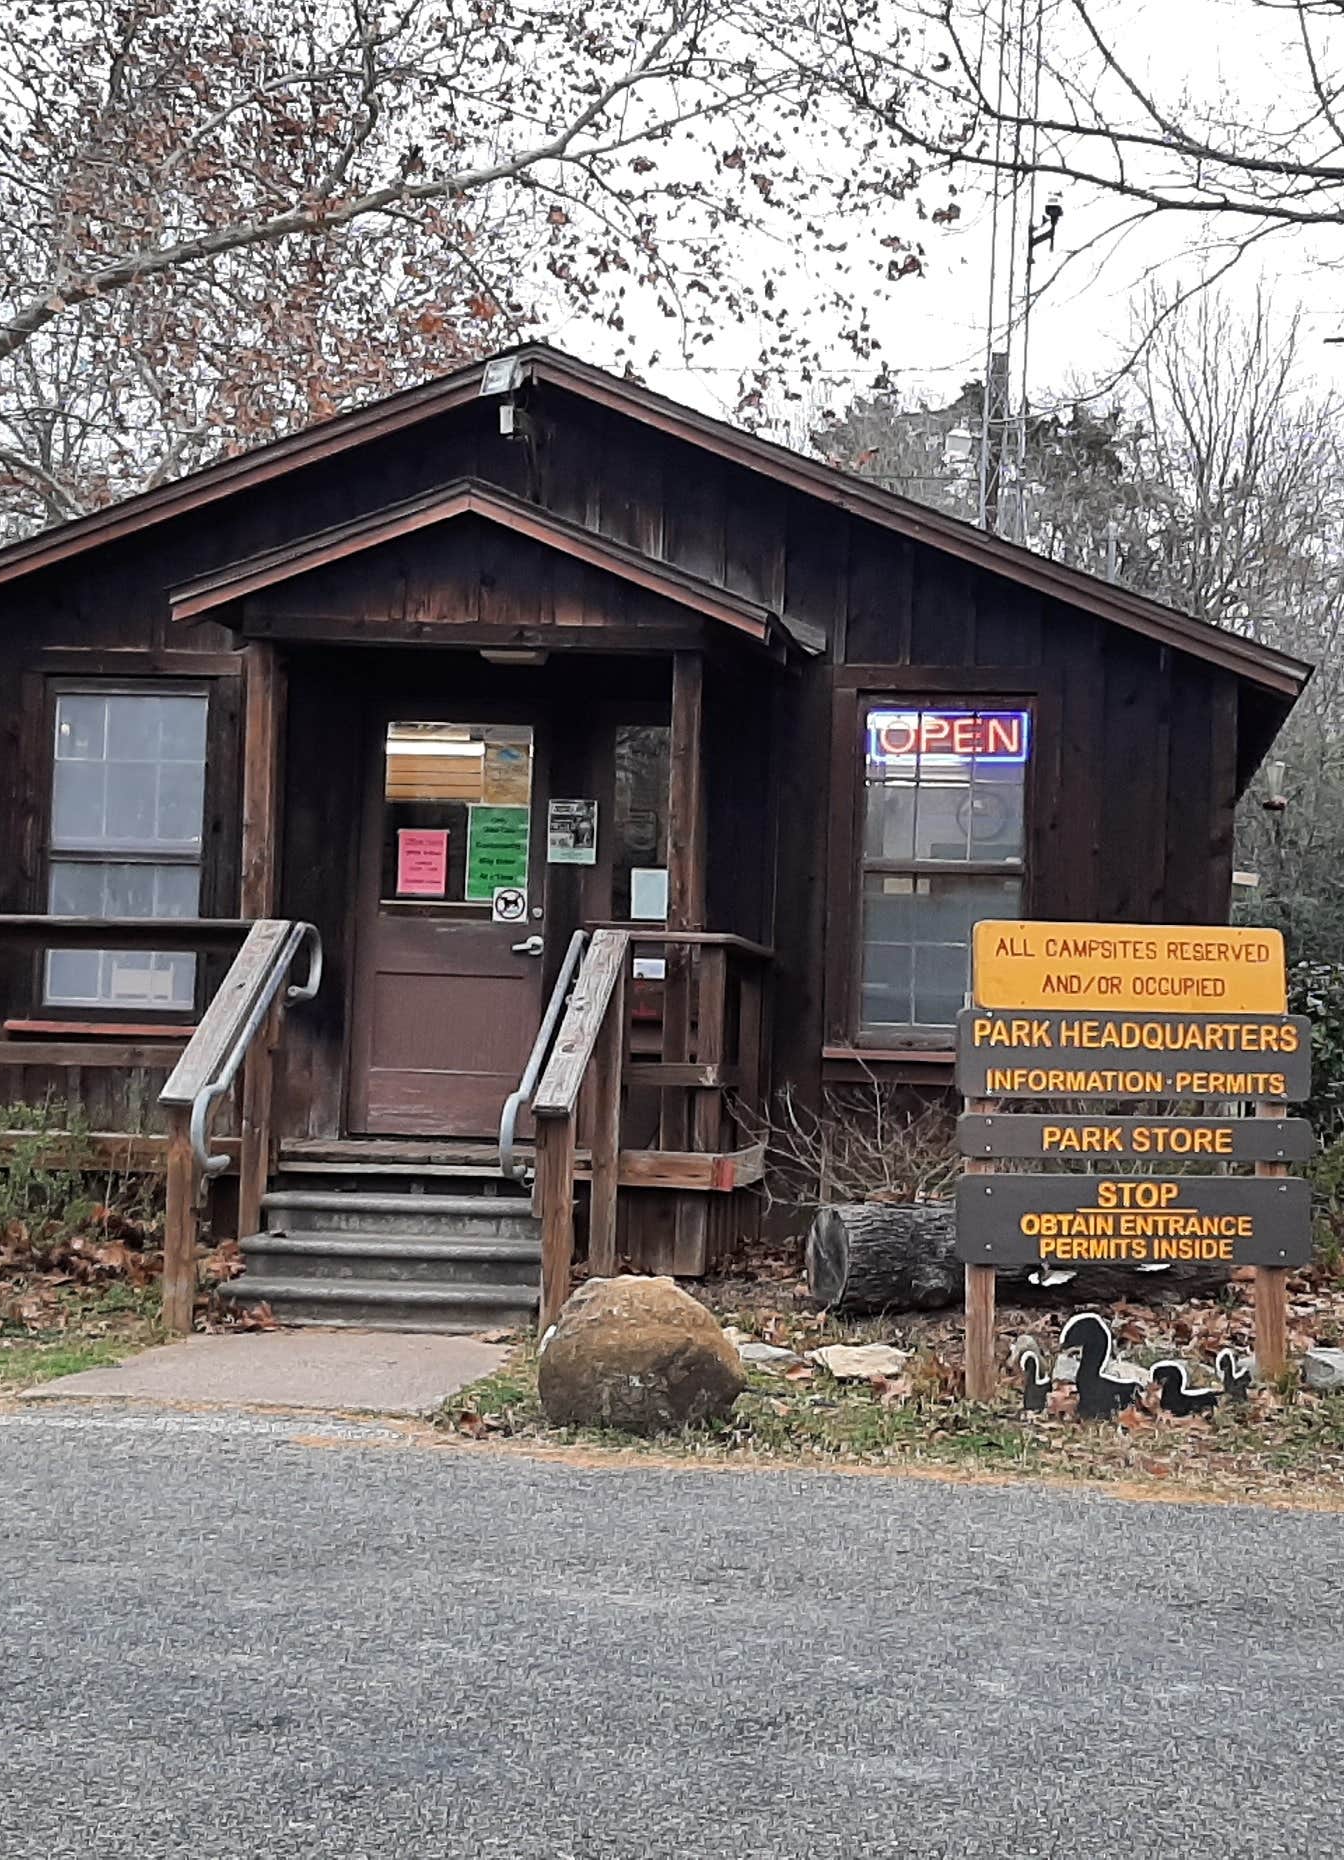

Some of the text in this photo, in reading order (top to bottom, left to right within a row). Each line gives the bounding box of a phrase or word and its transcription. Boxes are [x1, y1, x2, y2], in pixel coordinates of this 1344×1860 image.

[879, 717, 1020, 754] OPEN
[995, 937, 1270, 964] ALL CAMPSITES RESERVED
[1041, 974, 1226, 998] AND/OR OCCUPIED
[972, 1018, 1299, 1053] PARK HEADQUARTERS
[985, 1068, 1286, 1095] INFORMATION PERMITS
[1042, 1125, 1234, 1153] PARK STORE
[1097, 1180, 1181, 1208] STOP
[1019, 1213, 1254, 1237] OBTAIN ENTRANCE
[1039, 1238, 1235, 1260] PERMITS INSIDE
